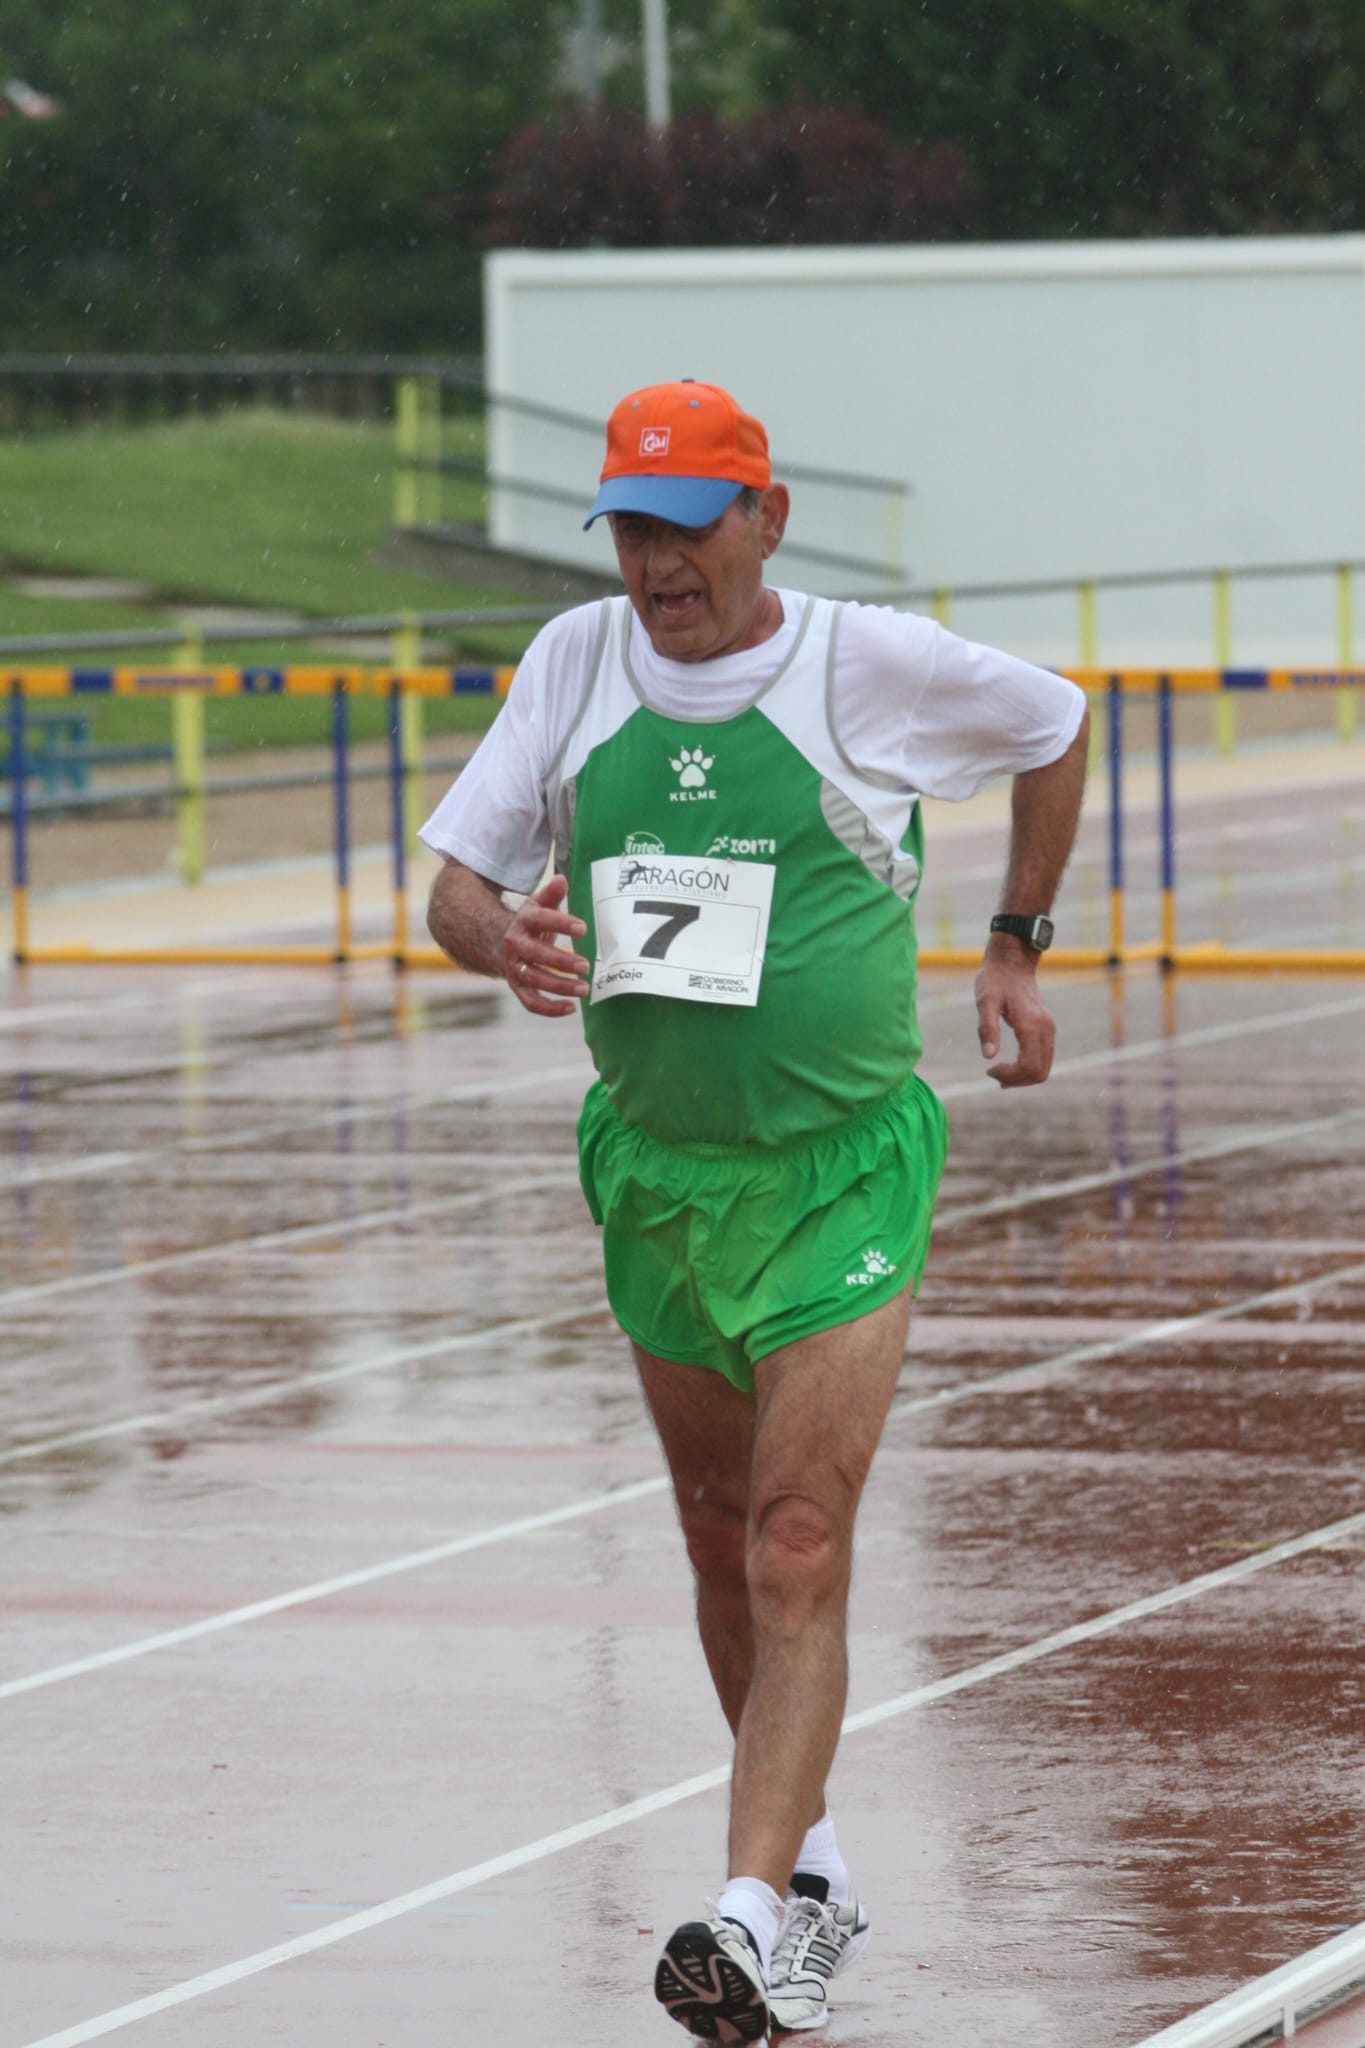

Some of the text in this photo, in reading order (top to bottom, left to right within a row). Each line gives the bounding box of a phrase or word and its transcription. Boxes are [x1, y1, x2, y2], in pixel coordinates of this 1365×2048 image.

[669, 790, 717, 802] KELME
[633, 866, 730, 892] ARAGÓN
[633, 900, 700, 960] 7
